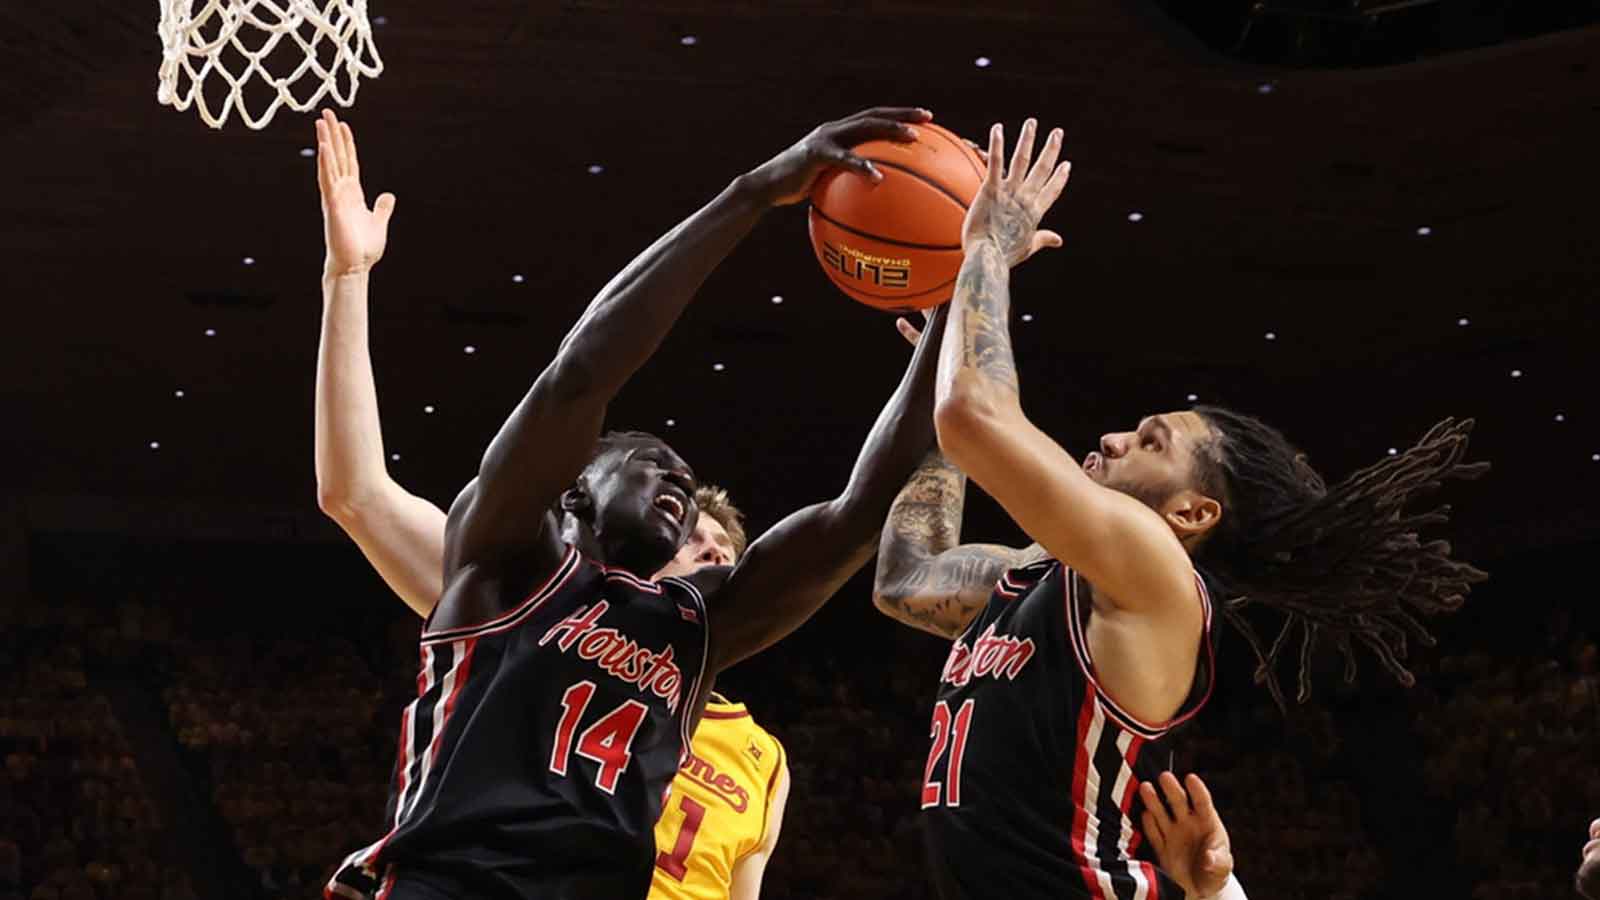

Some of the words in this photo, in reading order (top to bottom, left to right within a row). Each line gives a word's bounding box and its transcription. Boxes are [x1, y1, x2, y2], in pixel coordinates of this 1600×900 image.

[823, 240, 910, 288] ELITE
[550, 680, 649, 795] 14
[921, 698, 975, 809] 21
